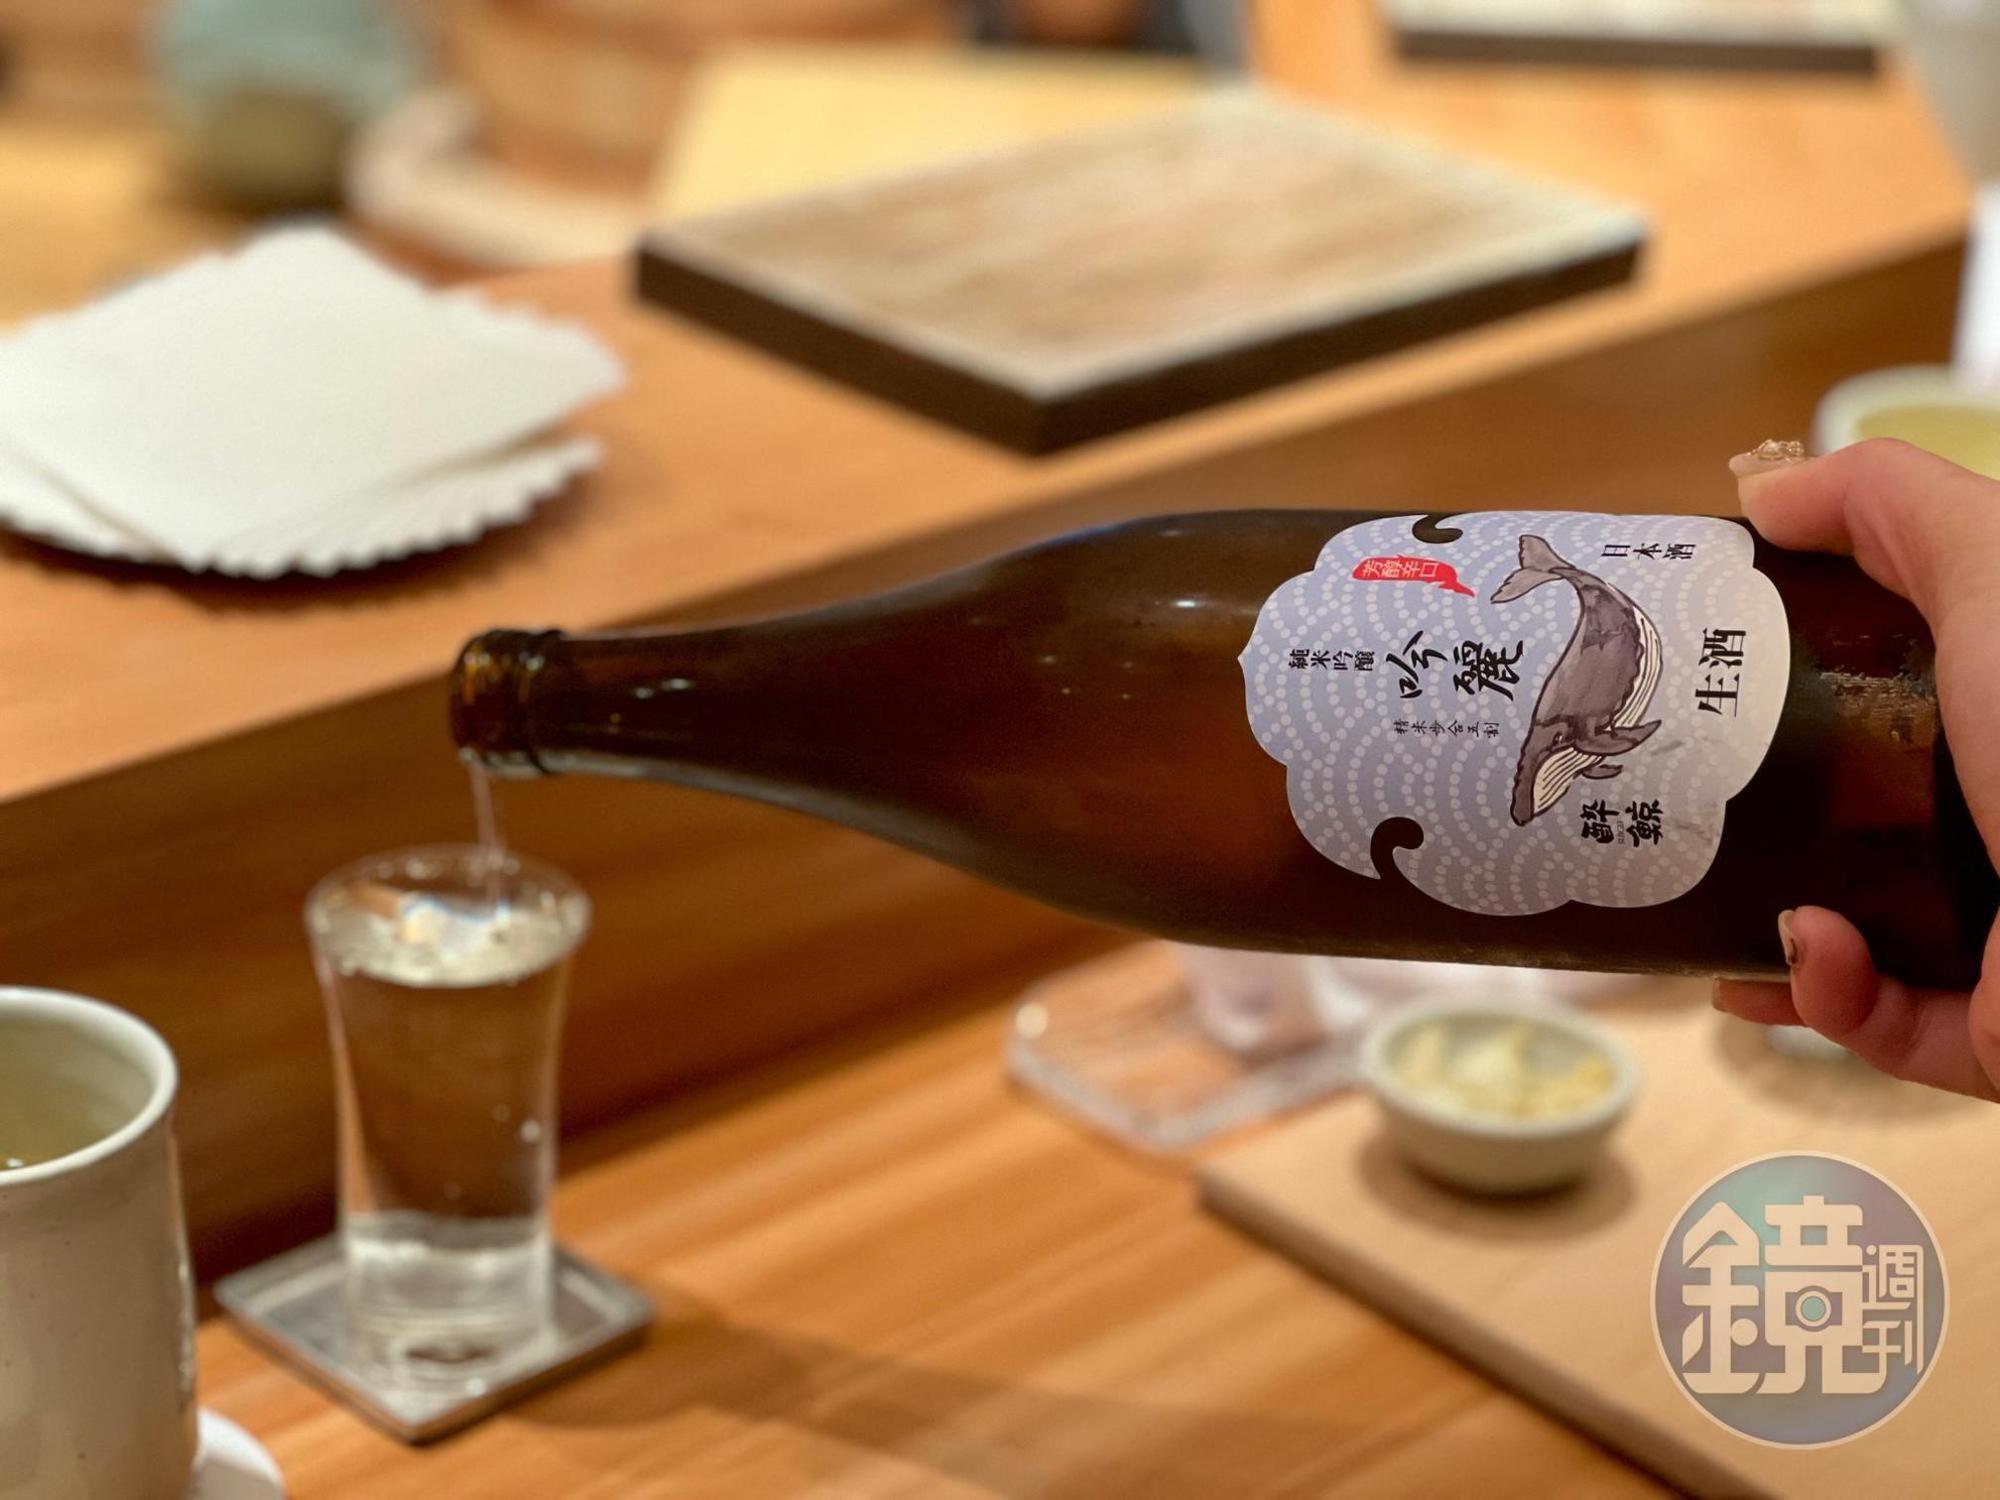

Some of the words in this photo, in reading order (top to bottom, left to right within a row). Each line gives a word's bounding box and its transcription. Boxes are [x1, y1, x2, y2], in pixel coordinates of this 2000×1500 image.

[1362, 559, 1439, 578] 芳醇辛口
[1601, 543, 1696, 560] 日本酒
[1386, 630, 1523, 701] 吟麗
[1695, 628, 1746, 717] 生酒
